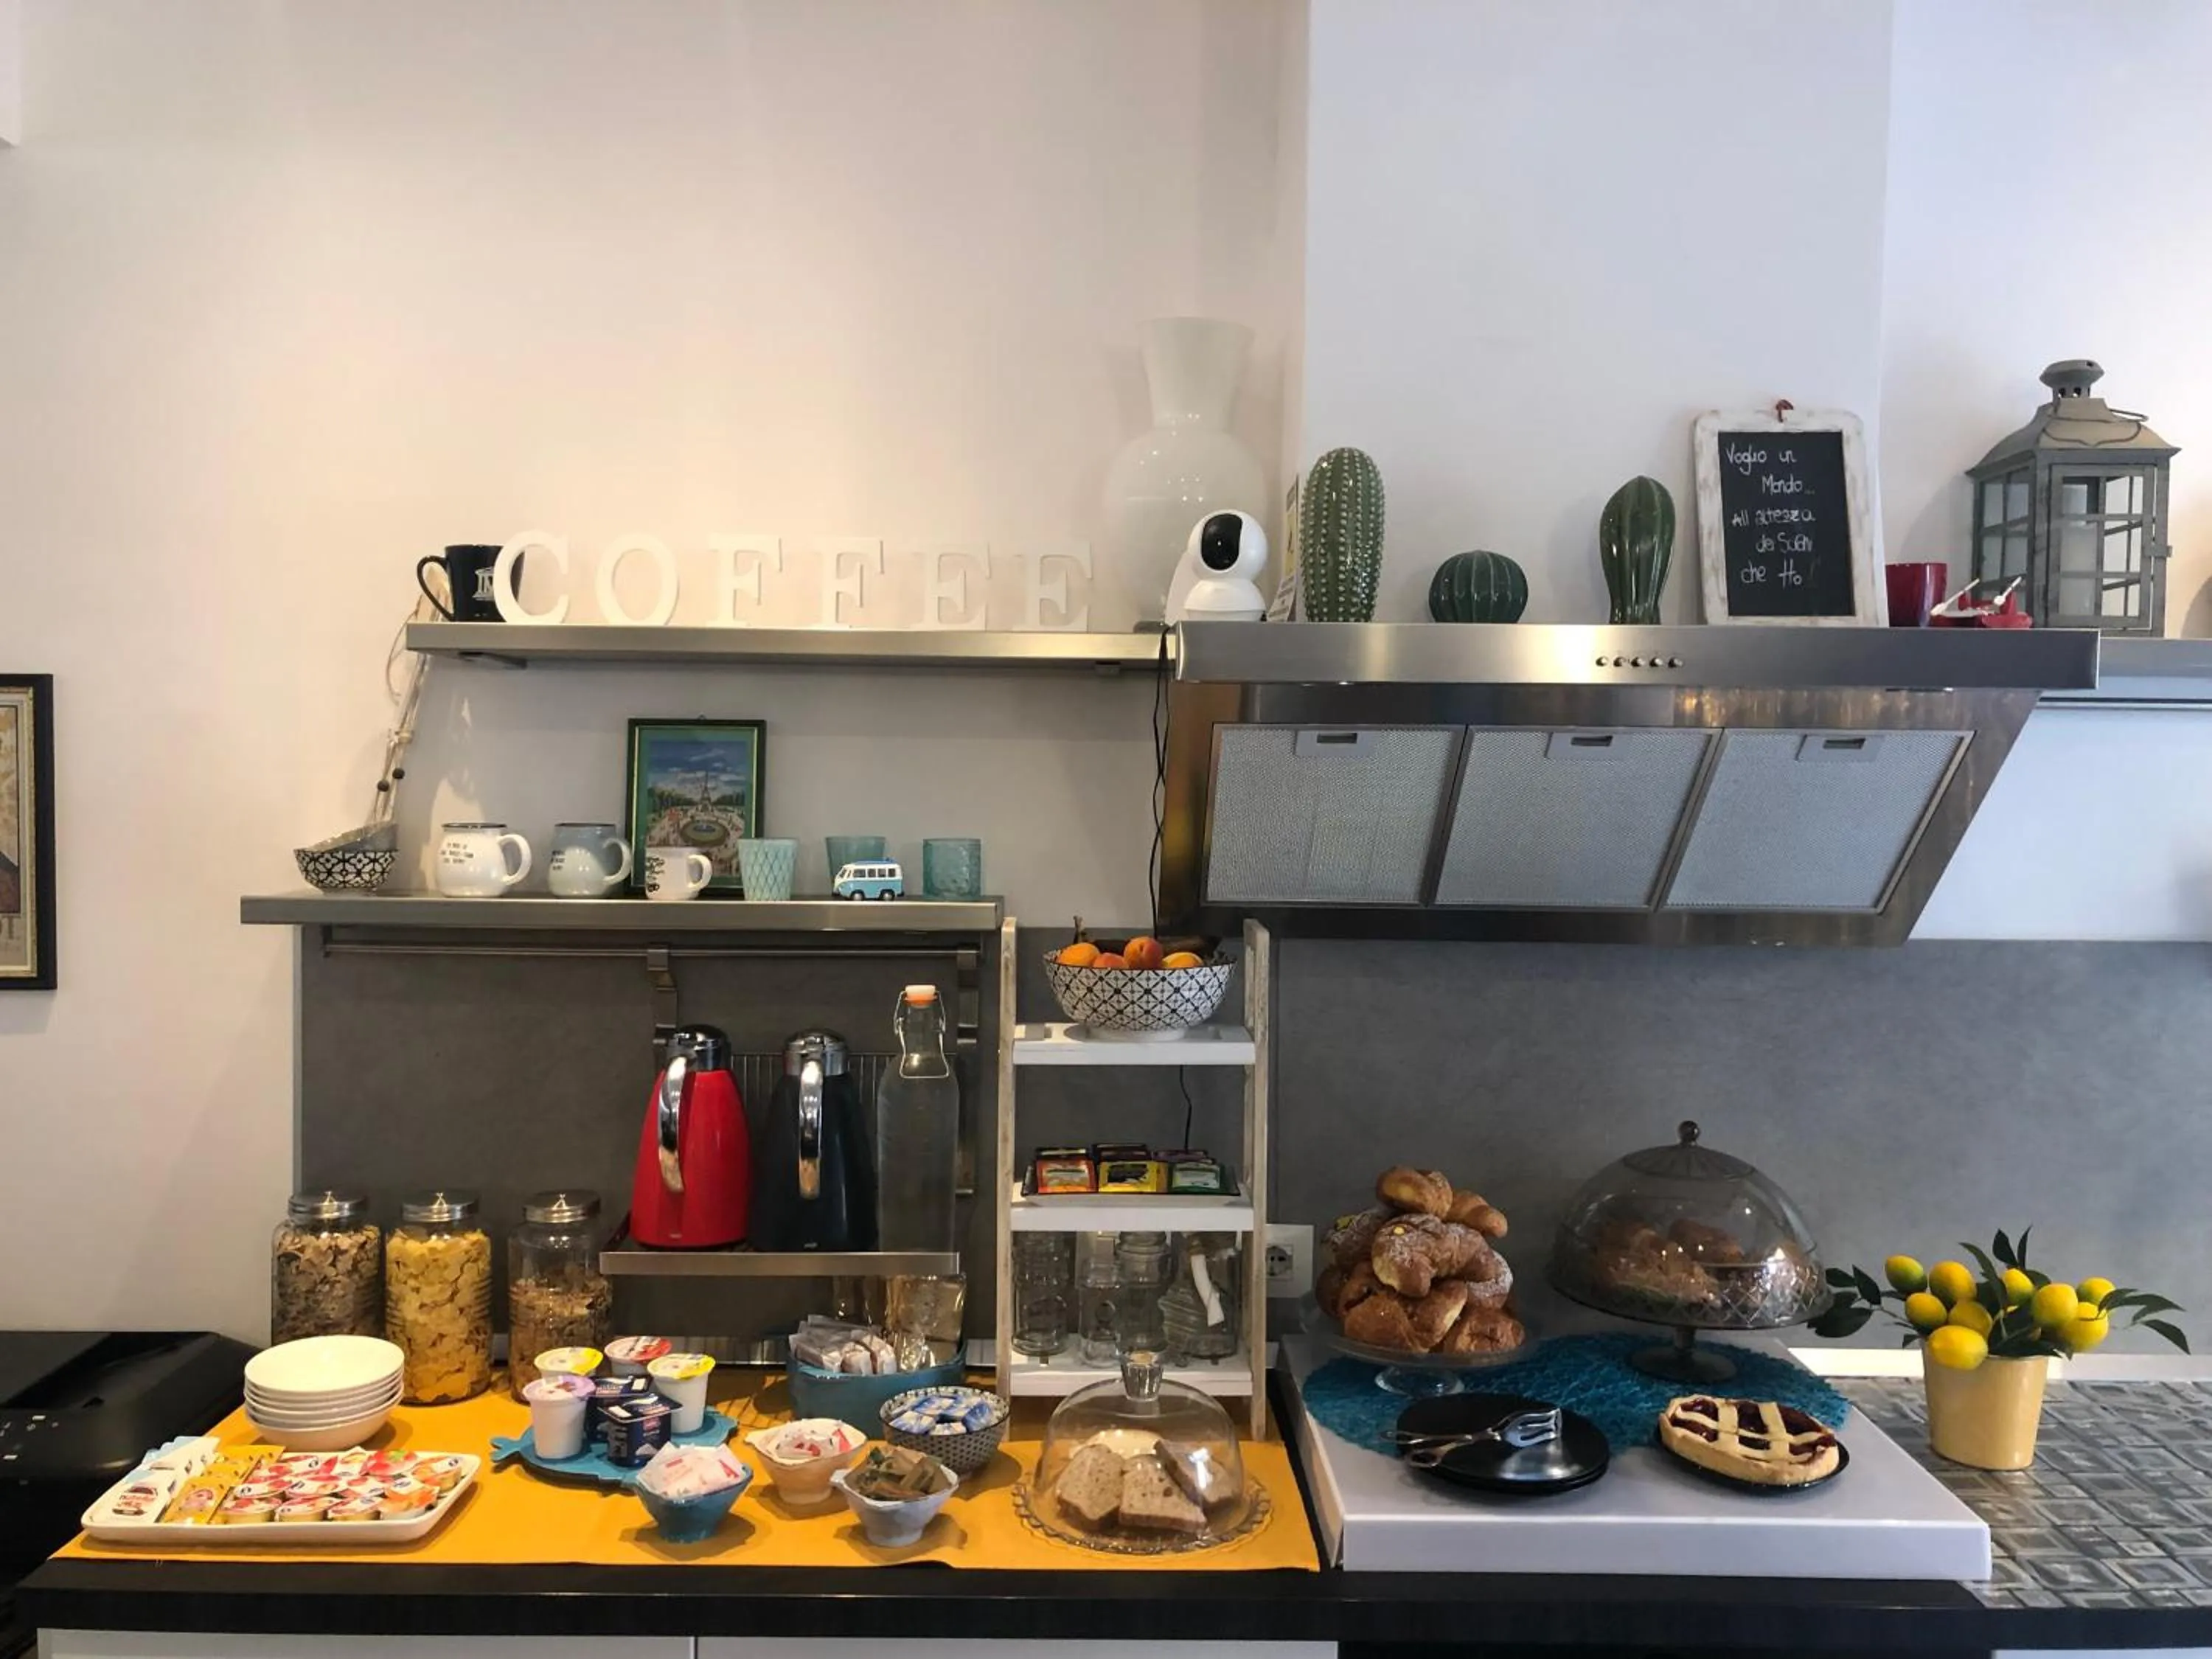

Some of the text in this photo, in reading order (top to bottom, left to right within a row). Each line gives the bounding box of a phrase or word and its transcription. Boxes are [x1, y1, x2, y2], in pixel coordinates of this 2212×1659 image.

[1726, 442, 1798, 476] Voglio un
[493, 529, 1093, 633] COFFEE
[1741, 560, 1767, 583] che
